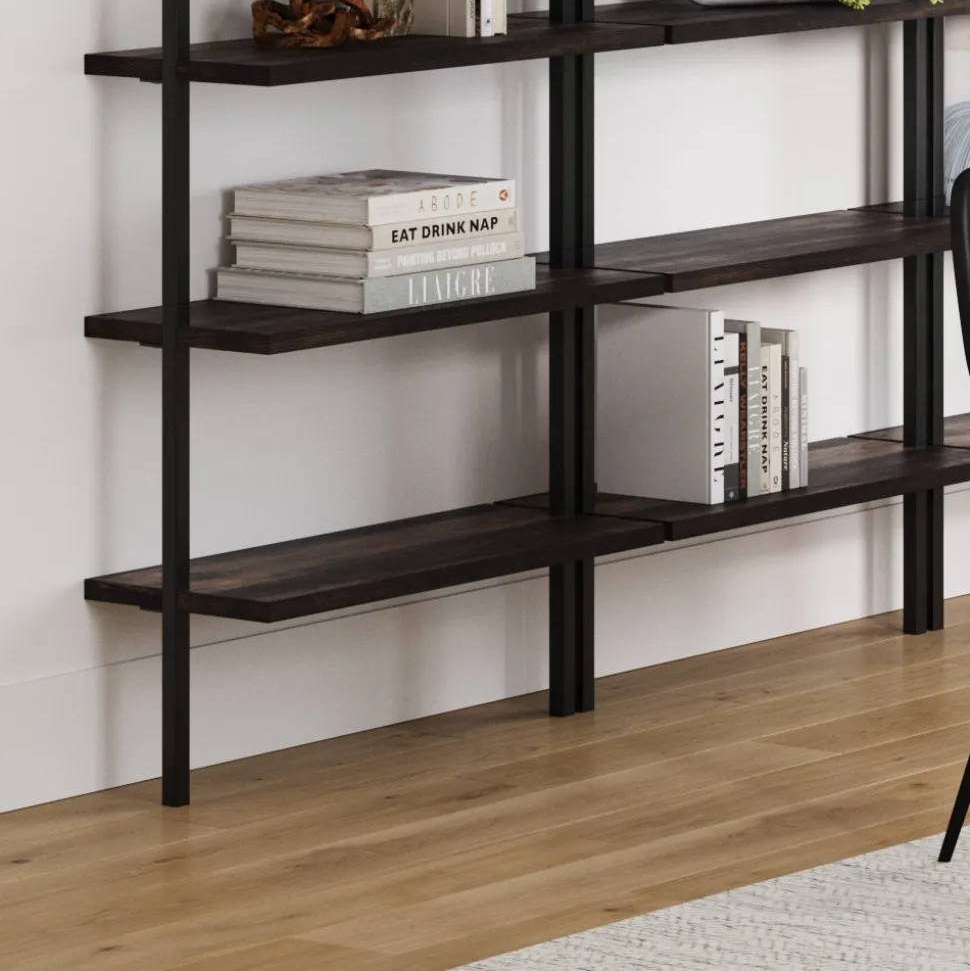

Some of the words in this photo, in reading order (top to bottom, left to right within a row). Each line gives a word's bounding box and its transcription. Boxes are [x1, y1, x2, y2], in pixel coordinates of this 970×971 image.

[391, 226, 418, 243] EAT
[421, 220, 466, 239] DRINK
[470, 216, 499, 233] NAP
[397, 250, 435, 268] PAINTING
[437, 246, 470, 263] BEYOND
[471, 241, 507, 258] POLLOCK
[408, 266, 496, 305] LIAIGRE
